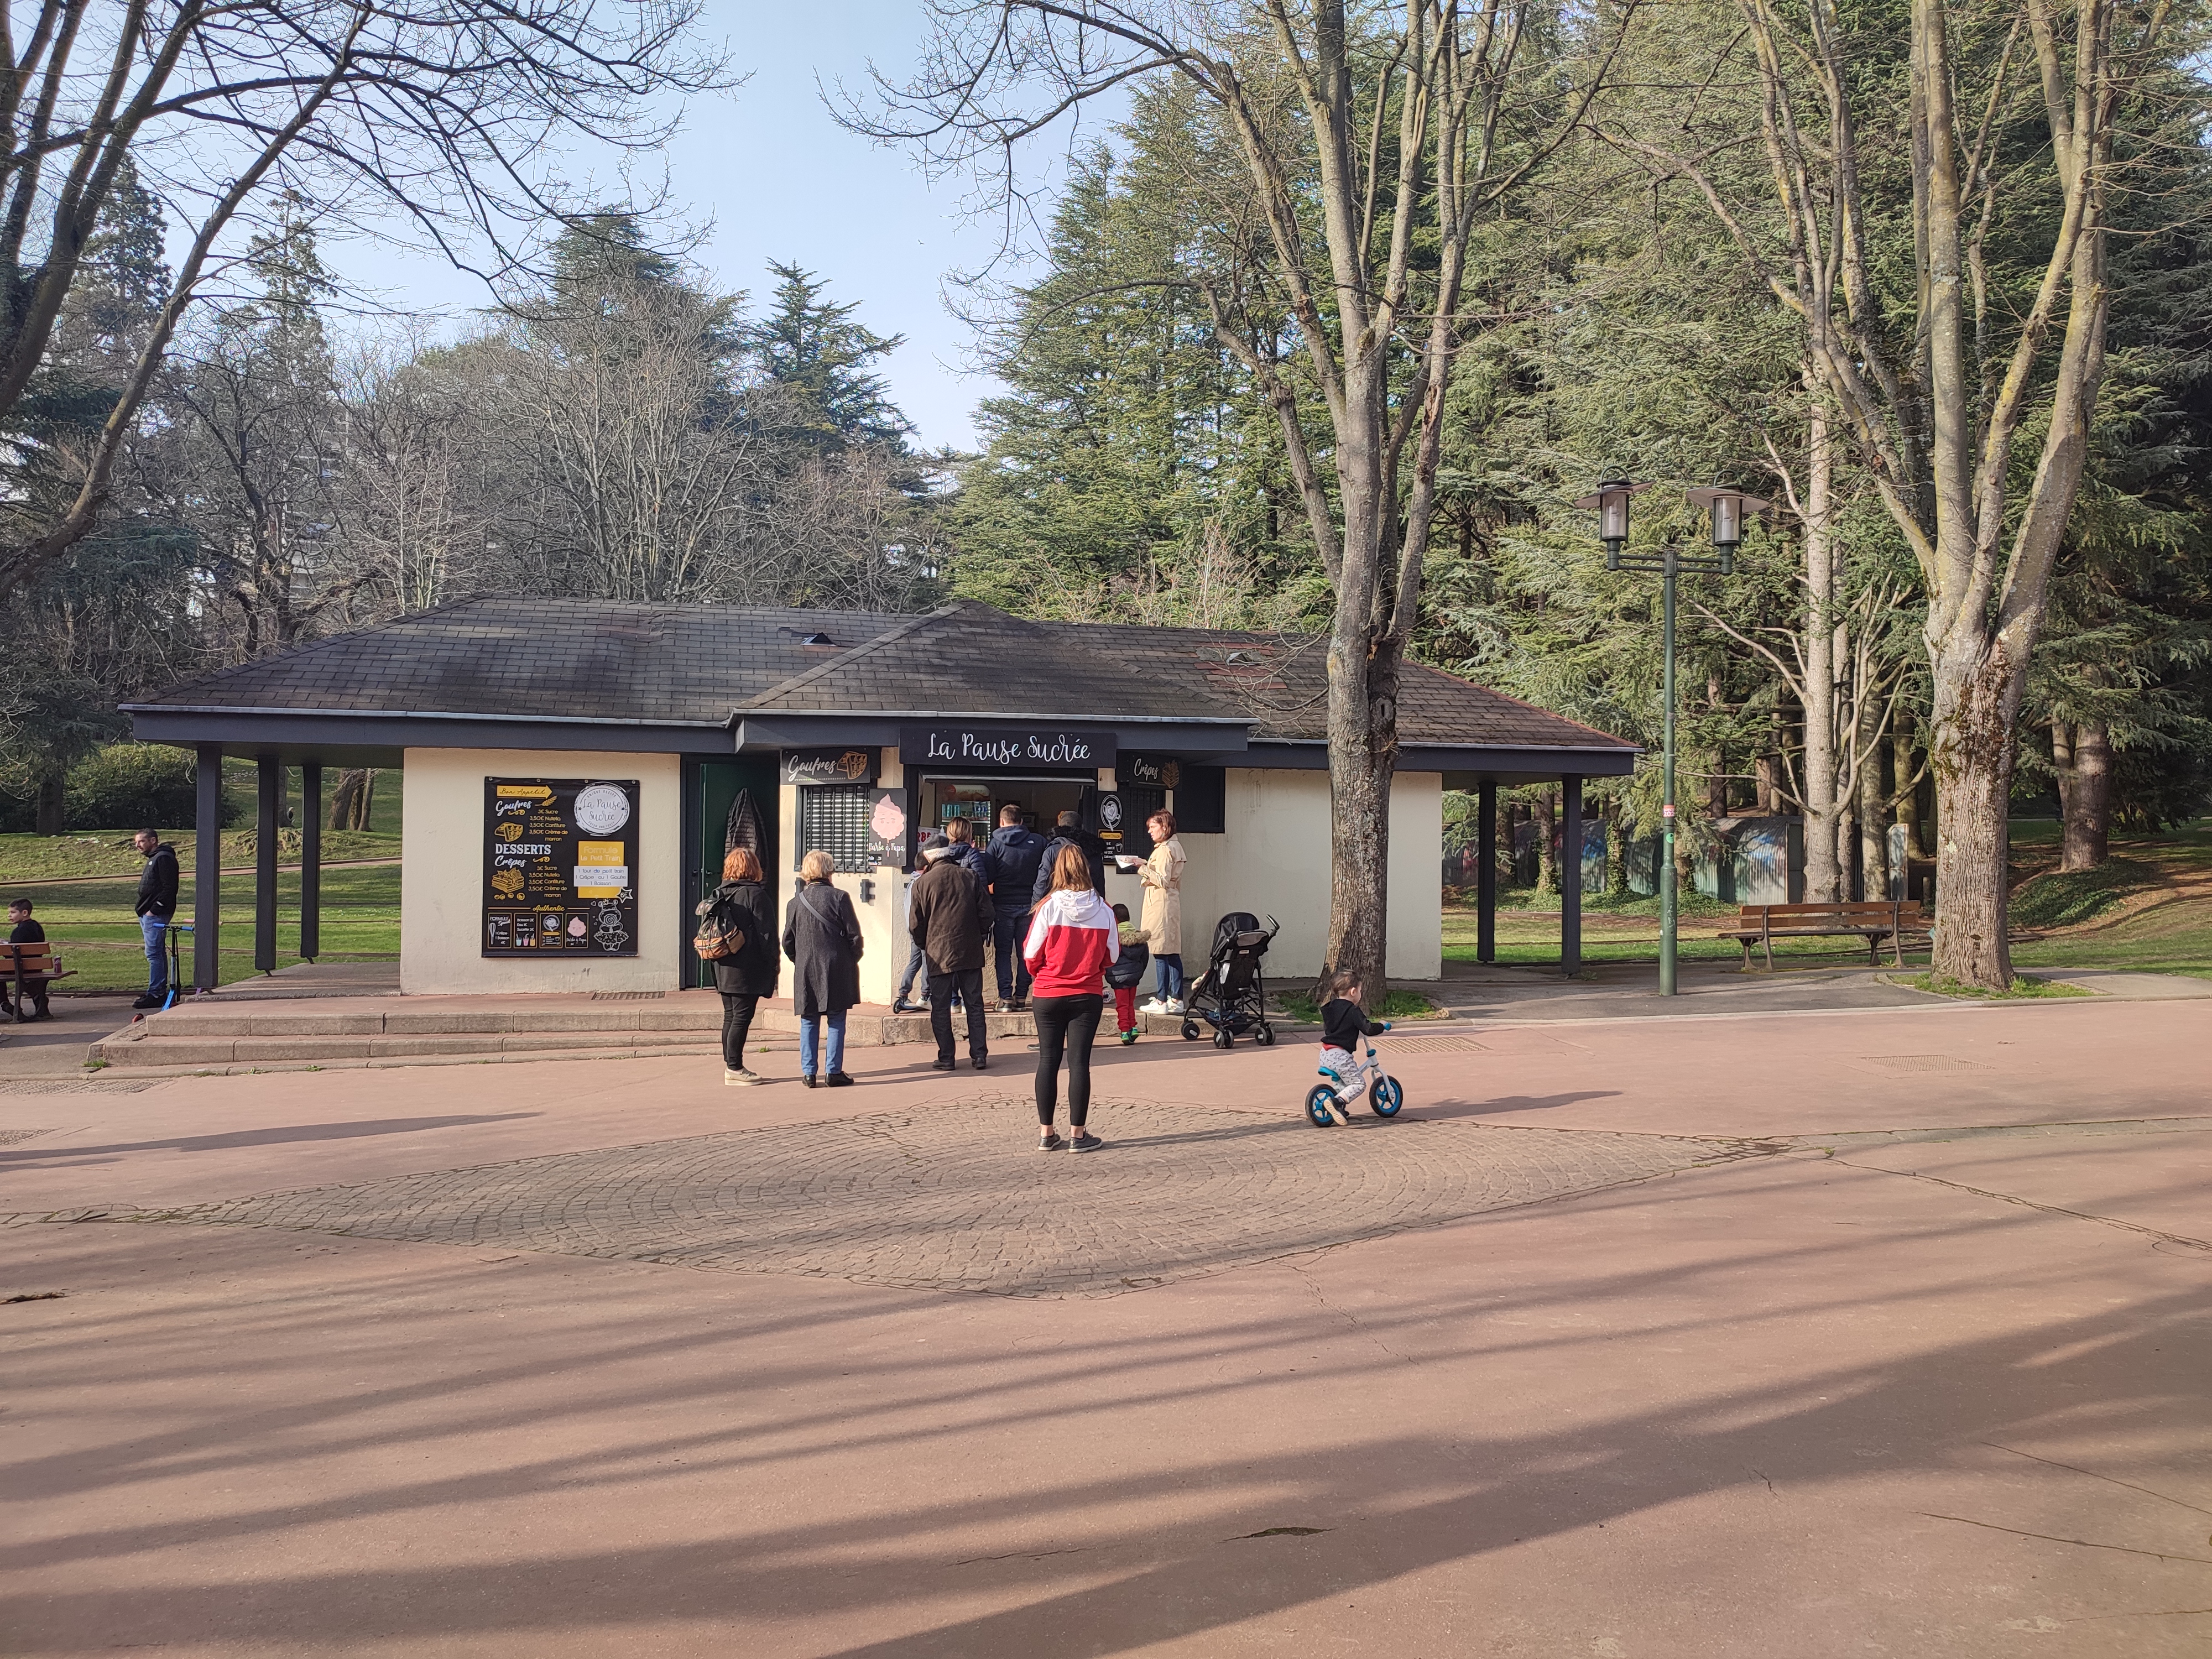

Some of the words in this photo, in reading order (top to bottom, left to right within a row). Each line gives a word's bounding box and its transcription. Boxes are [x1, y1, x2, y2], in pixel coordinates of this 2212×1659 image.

[928, 733, 956, 759] La
[962, 733, 1021, 764] Pause
[1027, 734, 1091, 762] Sucrée
[787, 754, 838, 782] Gaufres
[1134, 758, 1159, 781] Crêpes
[583, 799, 594, 809] La
[597, 799, 621, 811] Pause
[588, 810, 615, 822] Sucrée
[495, 843, 551, 855] DESSERTS
[583, 846, 618, 854] Formule
[868, 841, 885, 852] Barbe
[885, 843, 890, 852] à
[890, 843, 905, 856] Papa
[494, 855, 528, 869] Crêpes
